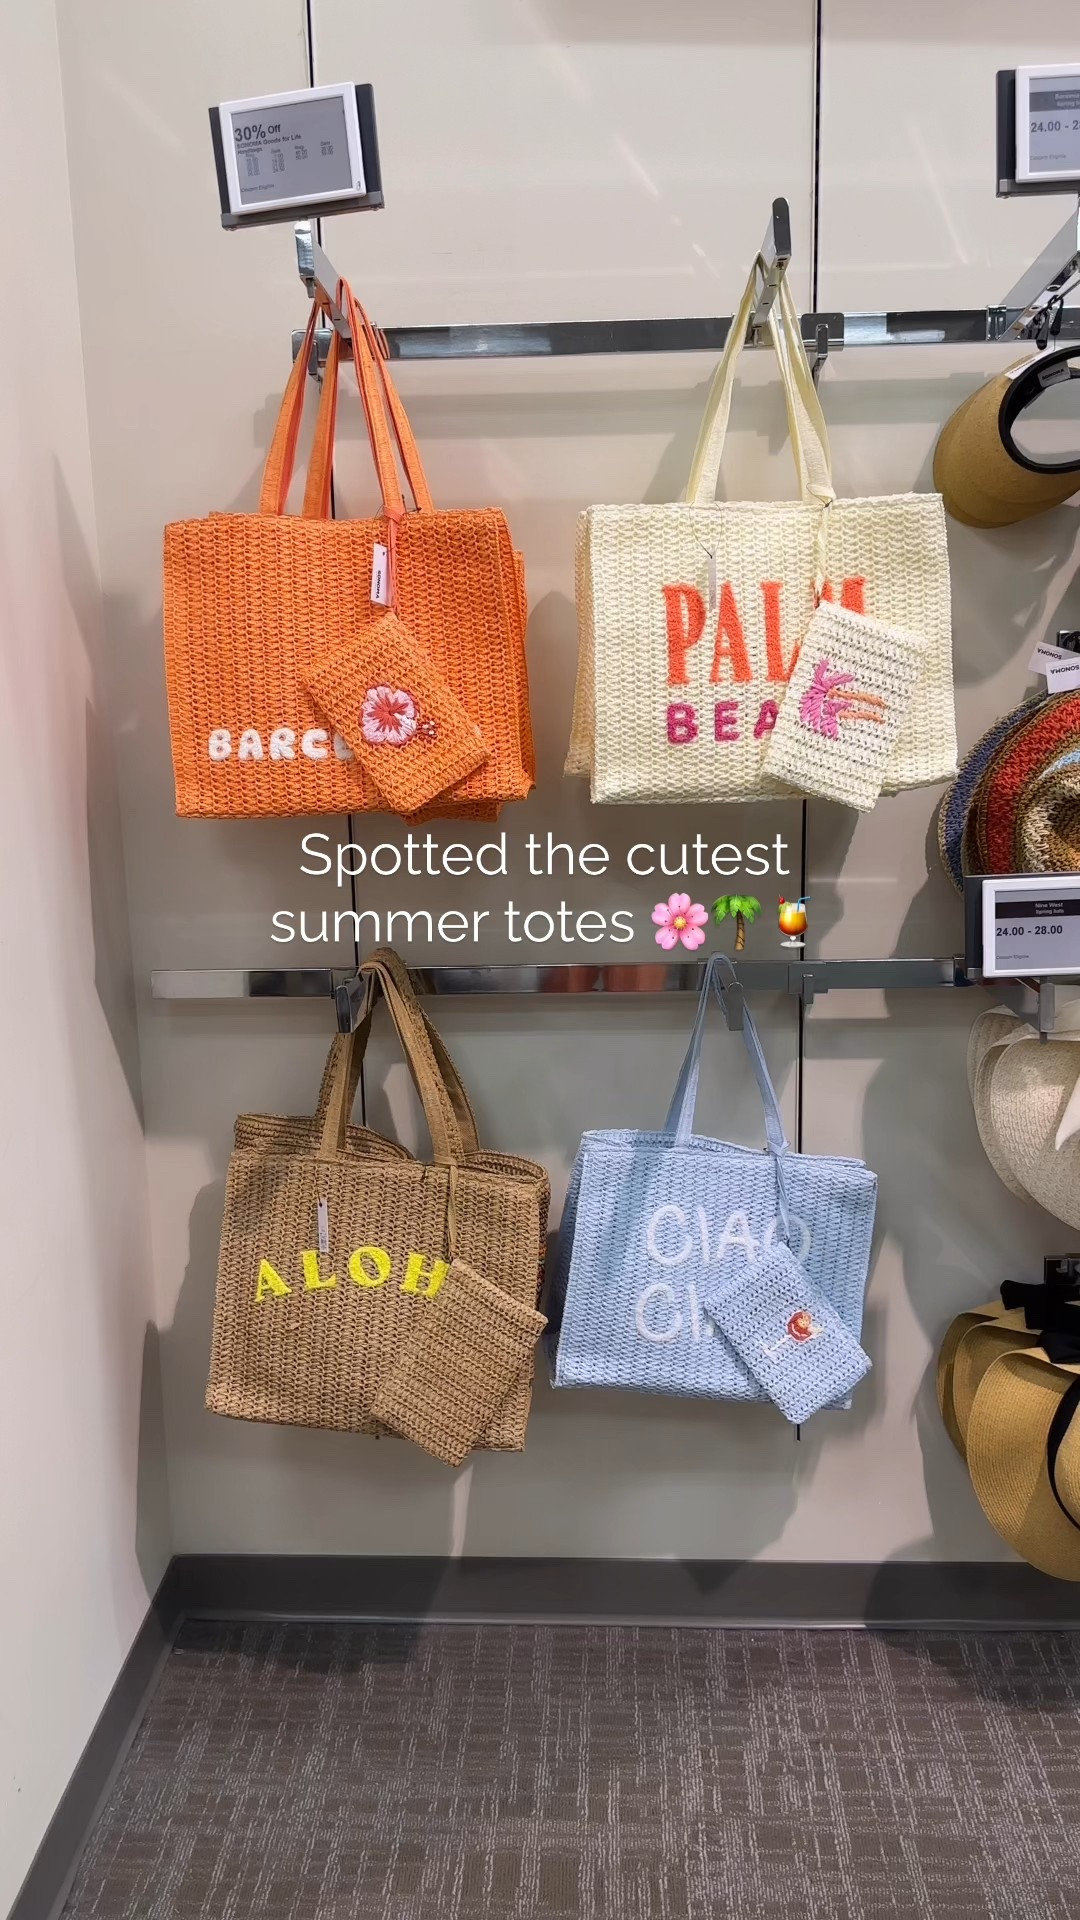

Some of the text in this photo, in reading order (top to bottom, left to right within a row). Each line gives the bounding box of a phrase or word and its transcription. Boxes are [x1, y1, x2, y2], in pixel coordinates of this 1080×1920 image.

[234, 124, 281, 142] 30% Off
[1030, 121, 1061, 133] 24.00
[1037, 647, 1062, 660] SONOMA
[1050, 664, 1080, 675] SONOMA
[996, 926, 1024, 937] 24.00
[1034, 925, 1063, 935] 28.00
[635, 1282, 716, 1343] CI
